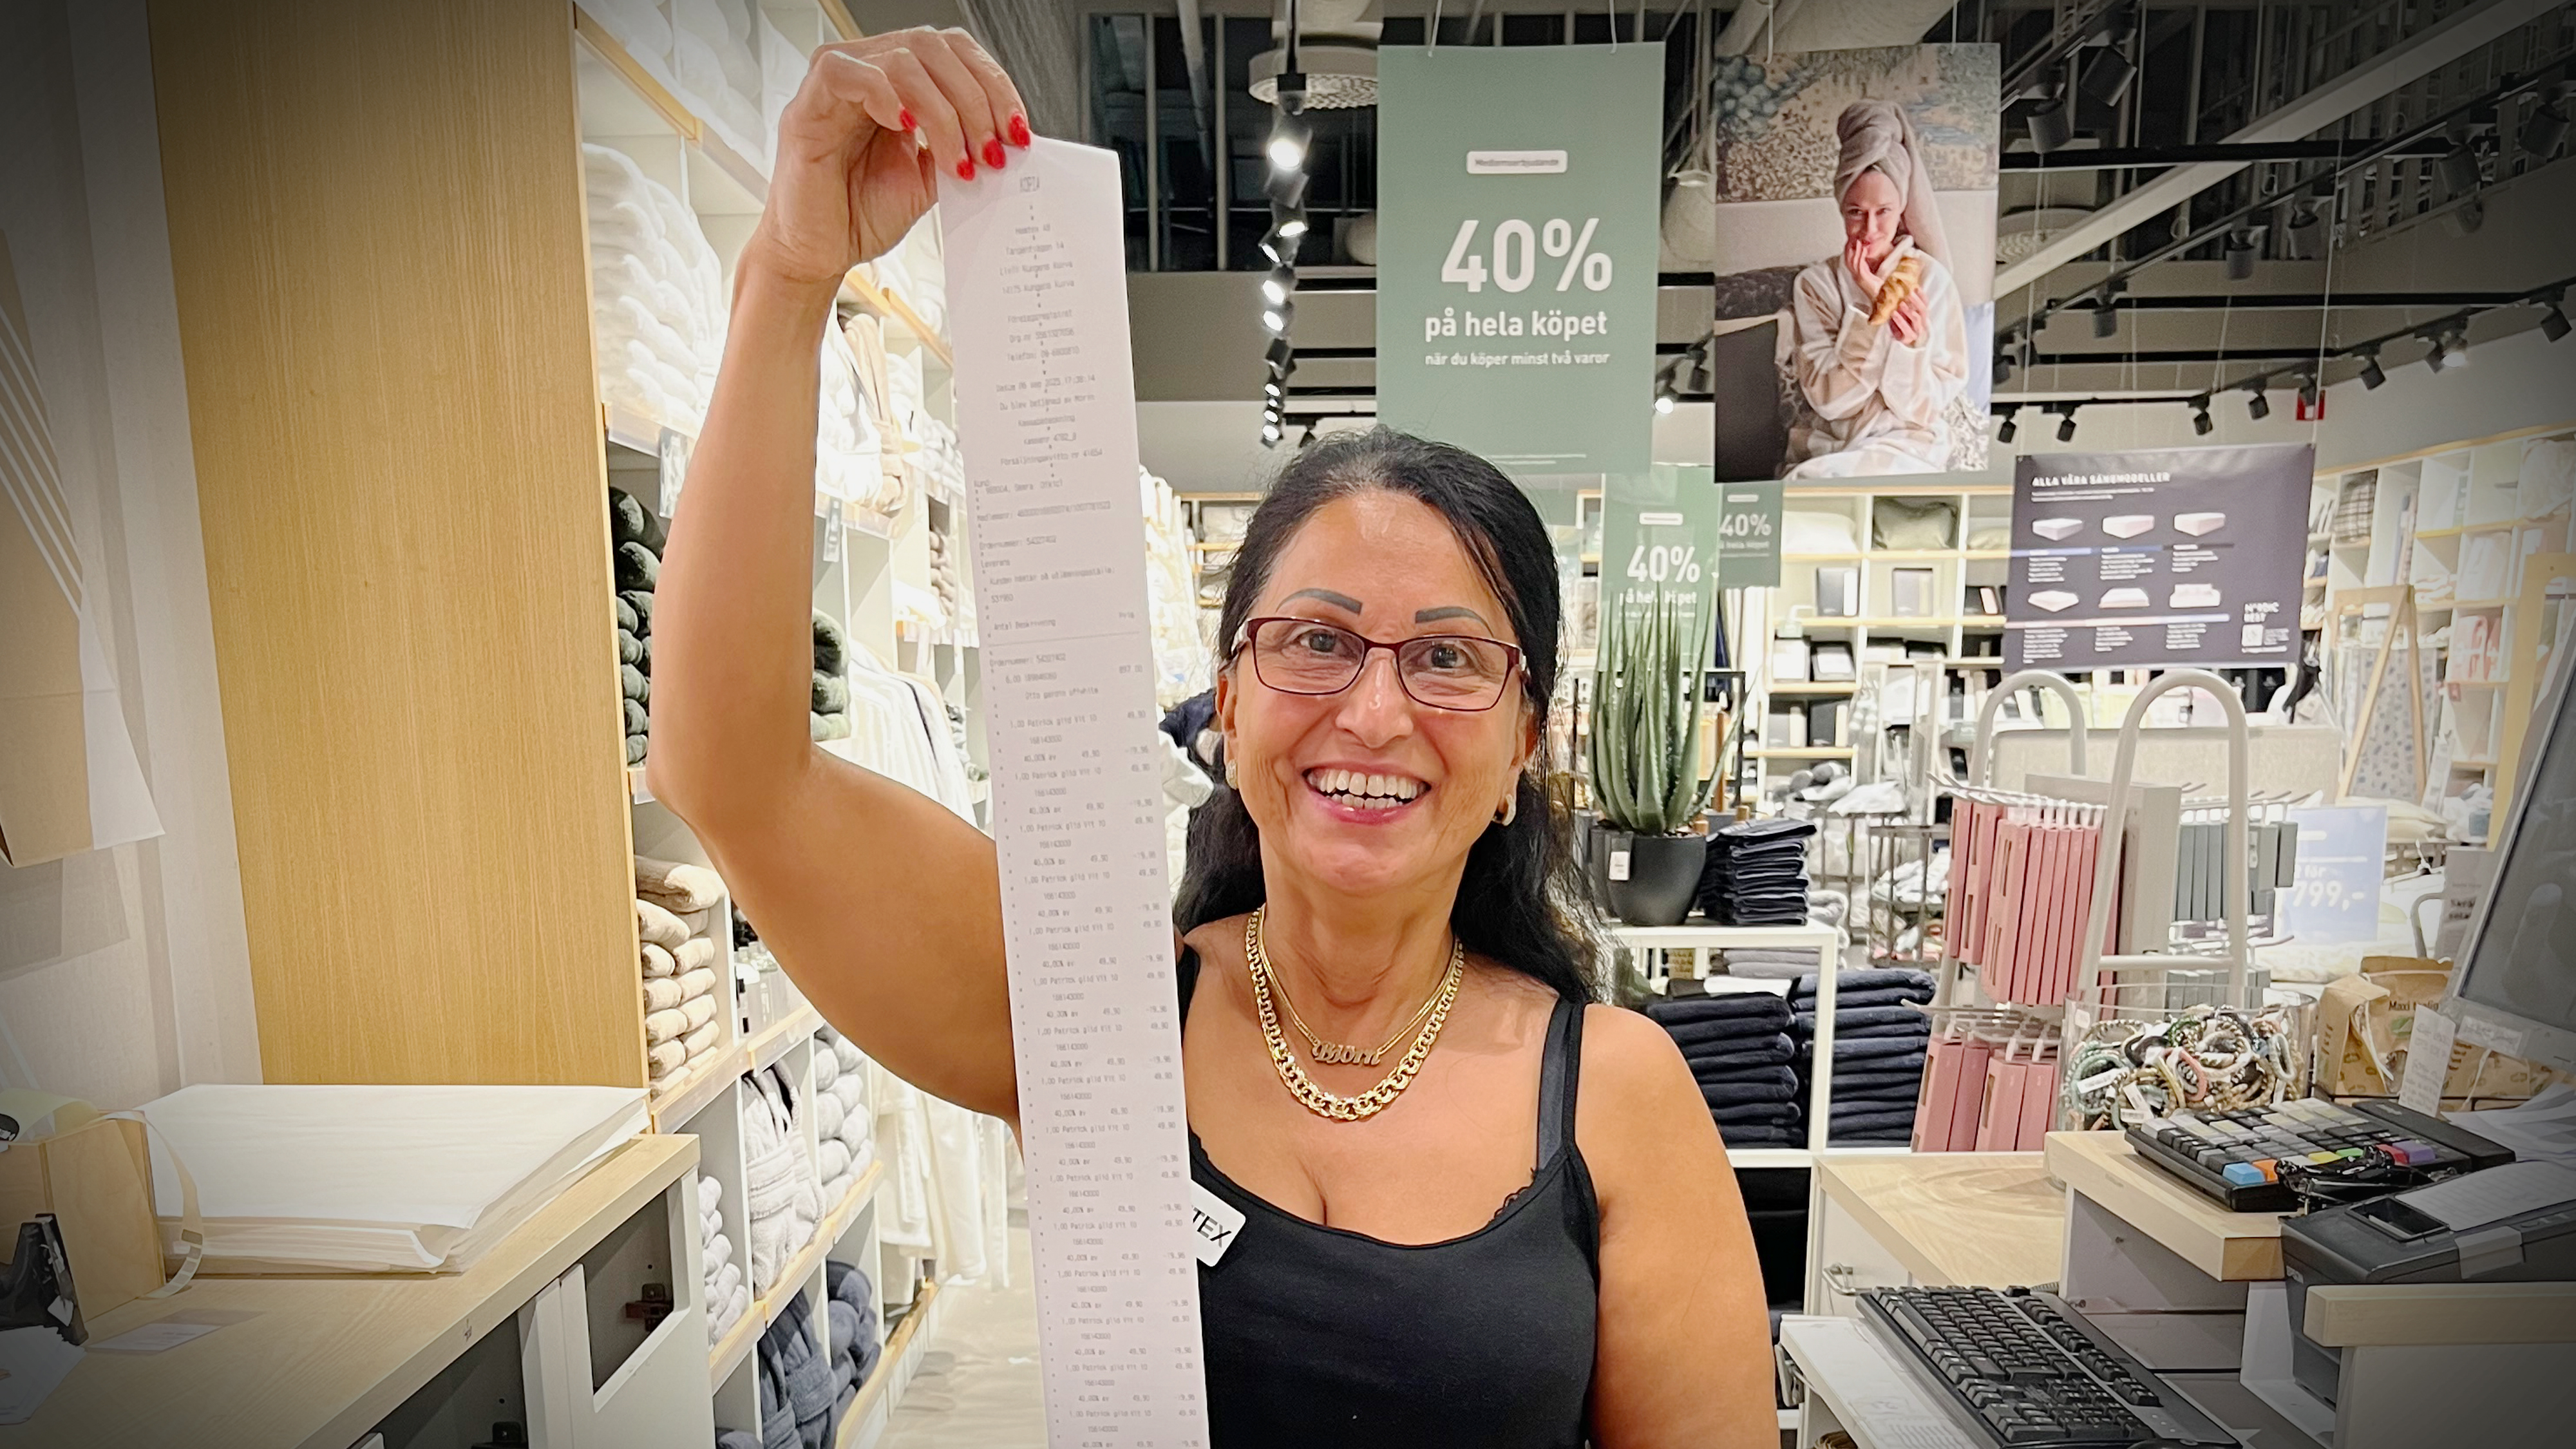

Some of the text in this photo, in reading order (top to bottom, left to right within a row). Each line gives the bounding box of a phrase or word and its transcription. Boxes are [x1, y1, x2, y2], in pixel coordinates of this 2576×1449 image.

[1441, 218, 1613, 293] 40%
[1426, 307, 1607, 342] på hela köpet
[1425, 350, 1610, 368] när du köper minst två varor
[1718, 513, 1772, 536] 40%
[1627, 545, 1701, 583] 40%
[1192, 1205, 1232, 1248] TEX
